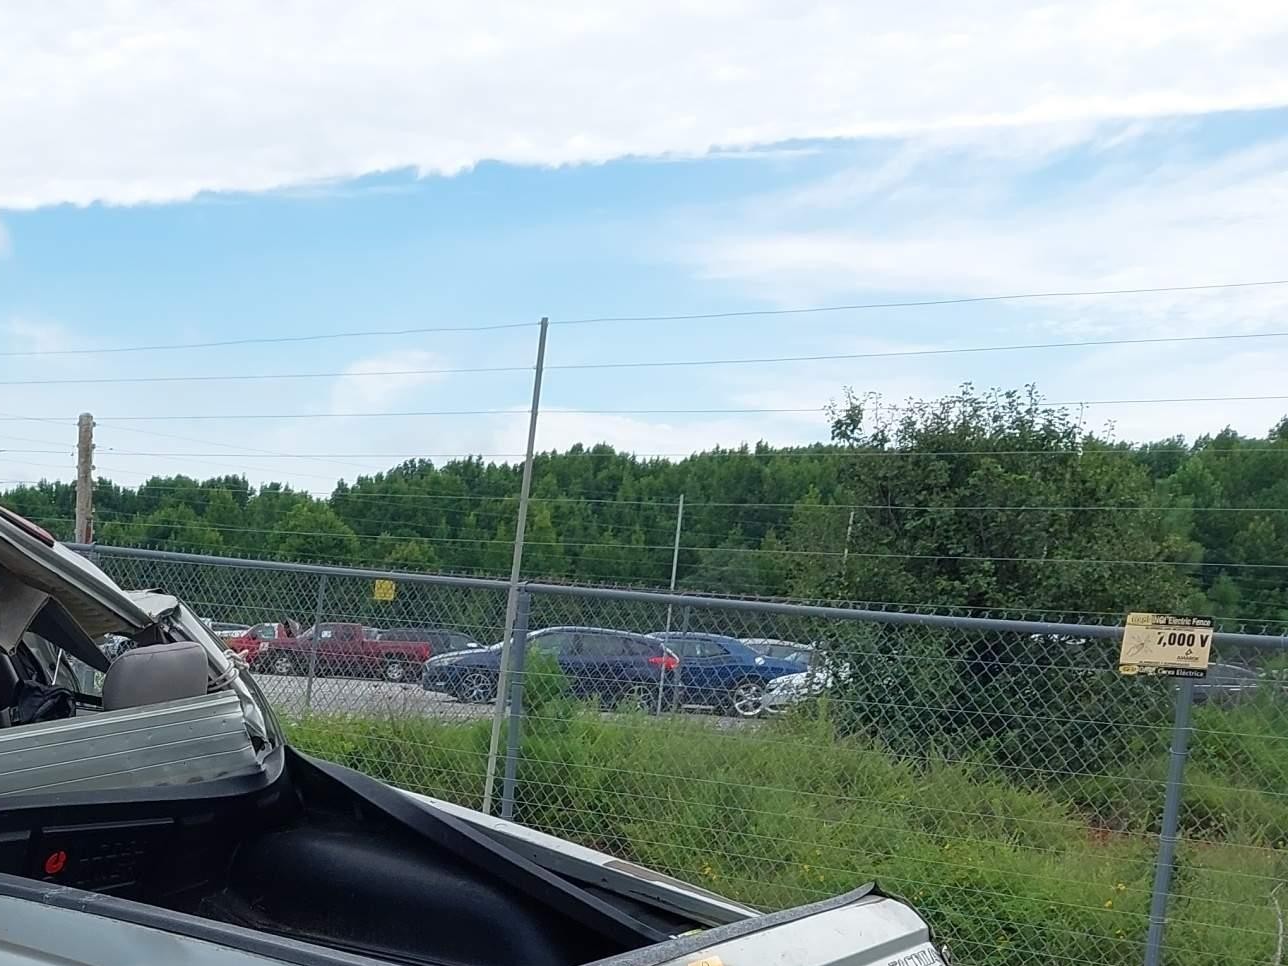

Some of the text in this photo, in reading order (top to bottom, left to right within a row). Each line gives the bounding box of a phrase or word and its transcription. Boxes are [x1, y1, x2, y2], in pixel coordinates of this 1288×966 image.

[1192, 618, 1211, 626] Fence
[1157, 631, 1210, 648] 7,000 V
